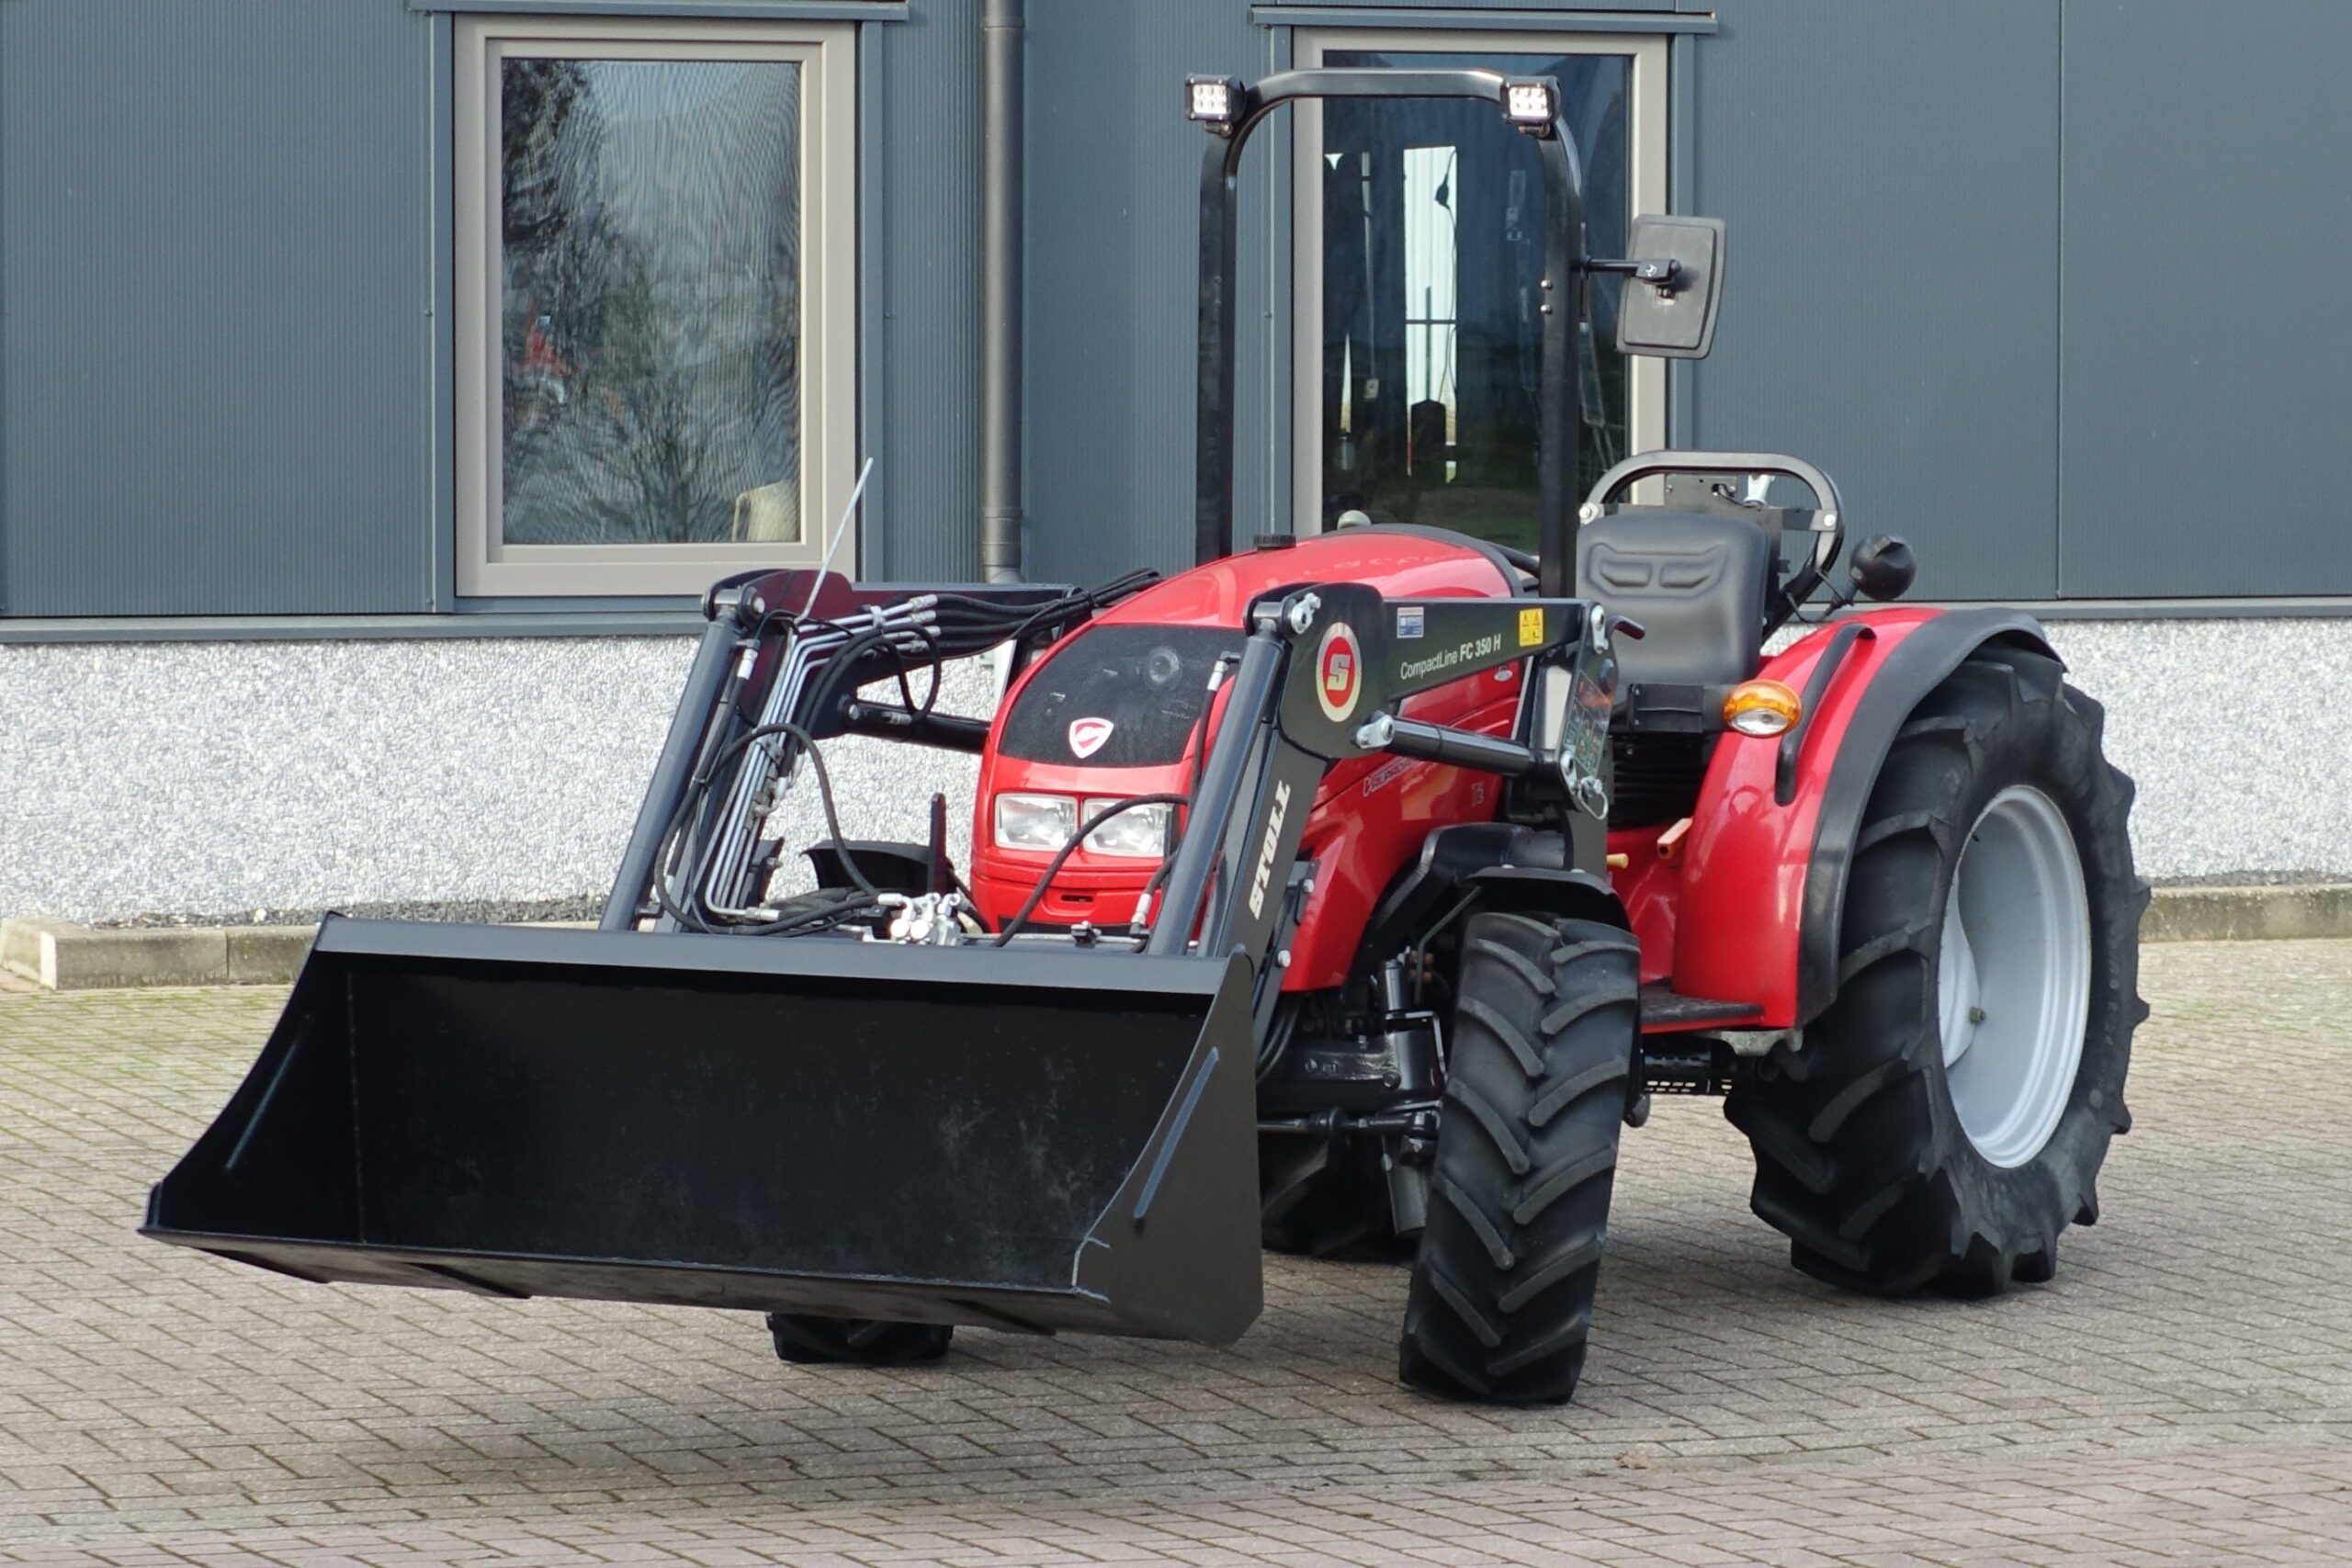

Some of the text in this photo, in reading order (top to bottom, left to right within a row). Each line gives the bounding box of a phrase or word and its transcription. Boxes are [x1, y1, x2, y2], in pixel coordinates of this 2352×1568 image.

[1400, 633, 1501, 680] CompactLine FC 350 H
[1249, 779, 1292, 920] STOLL
